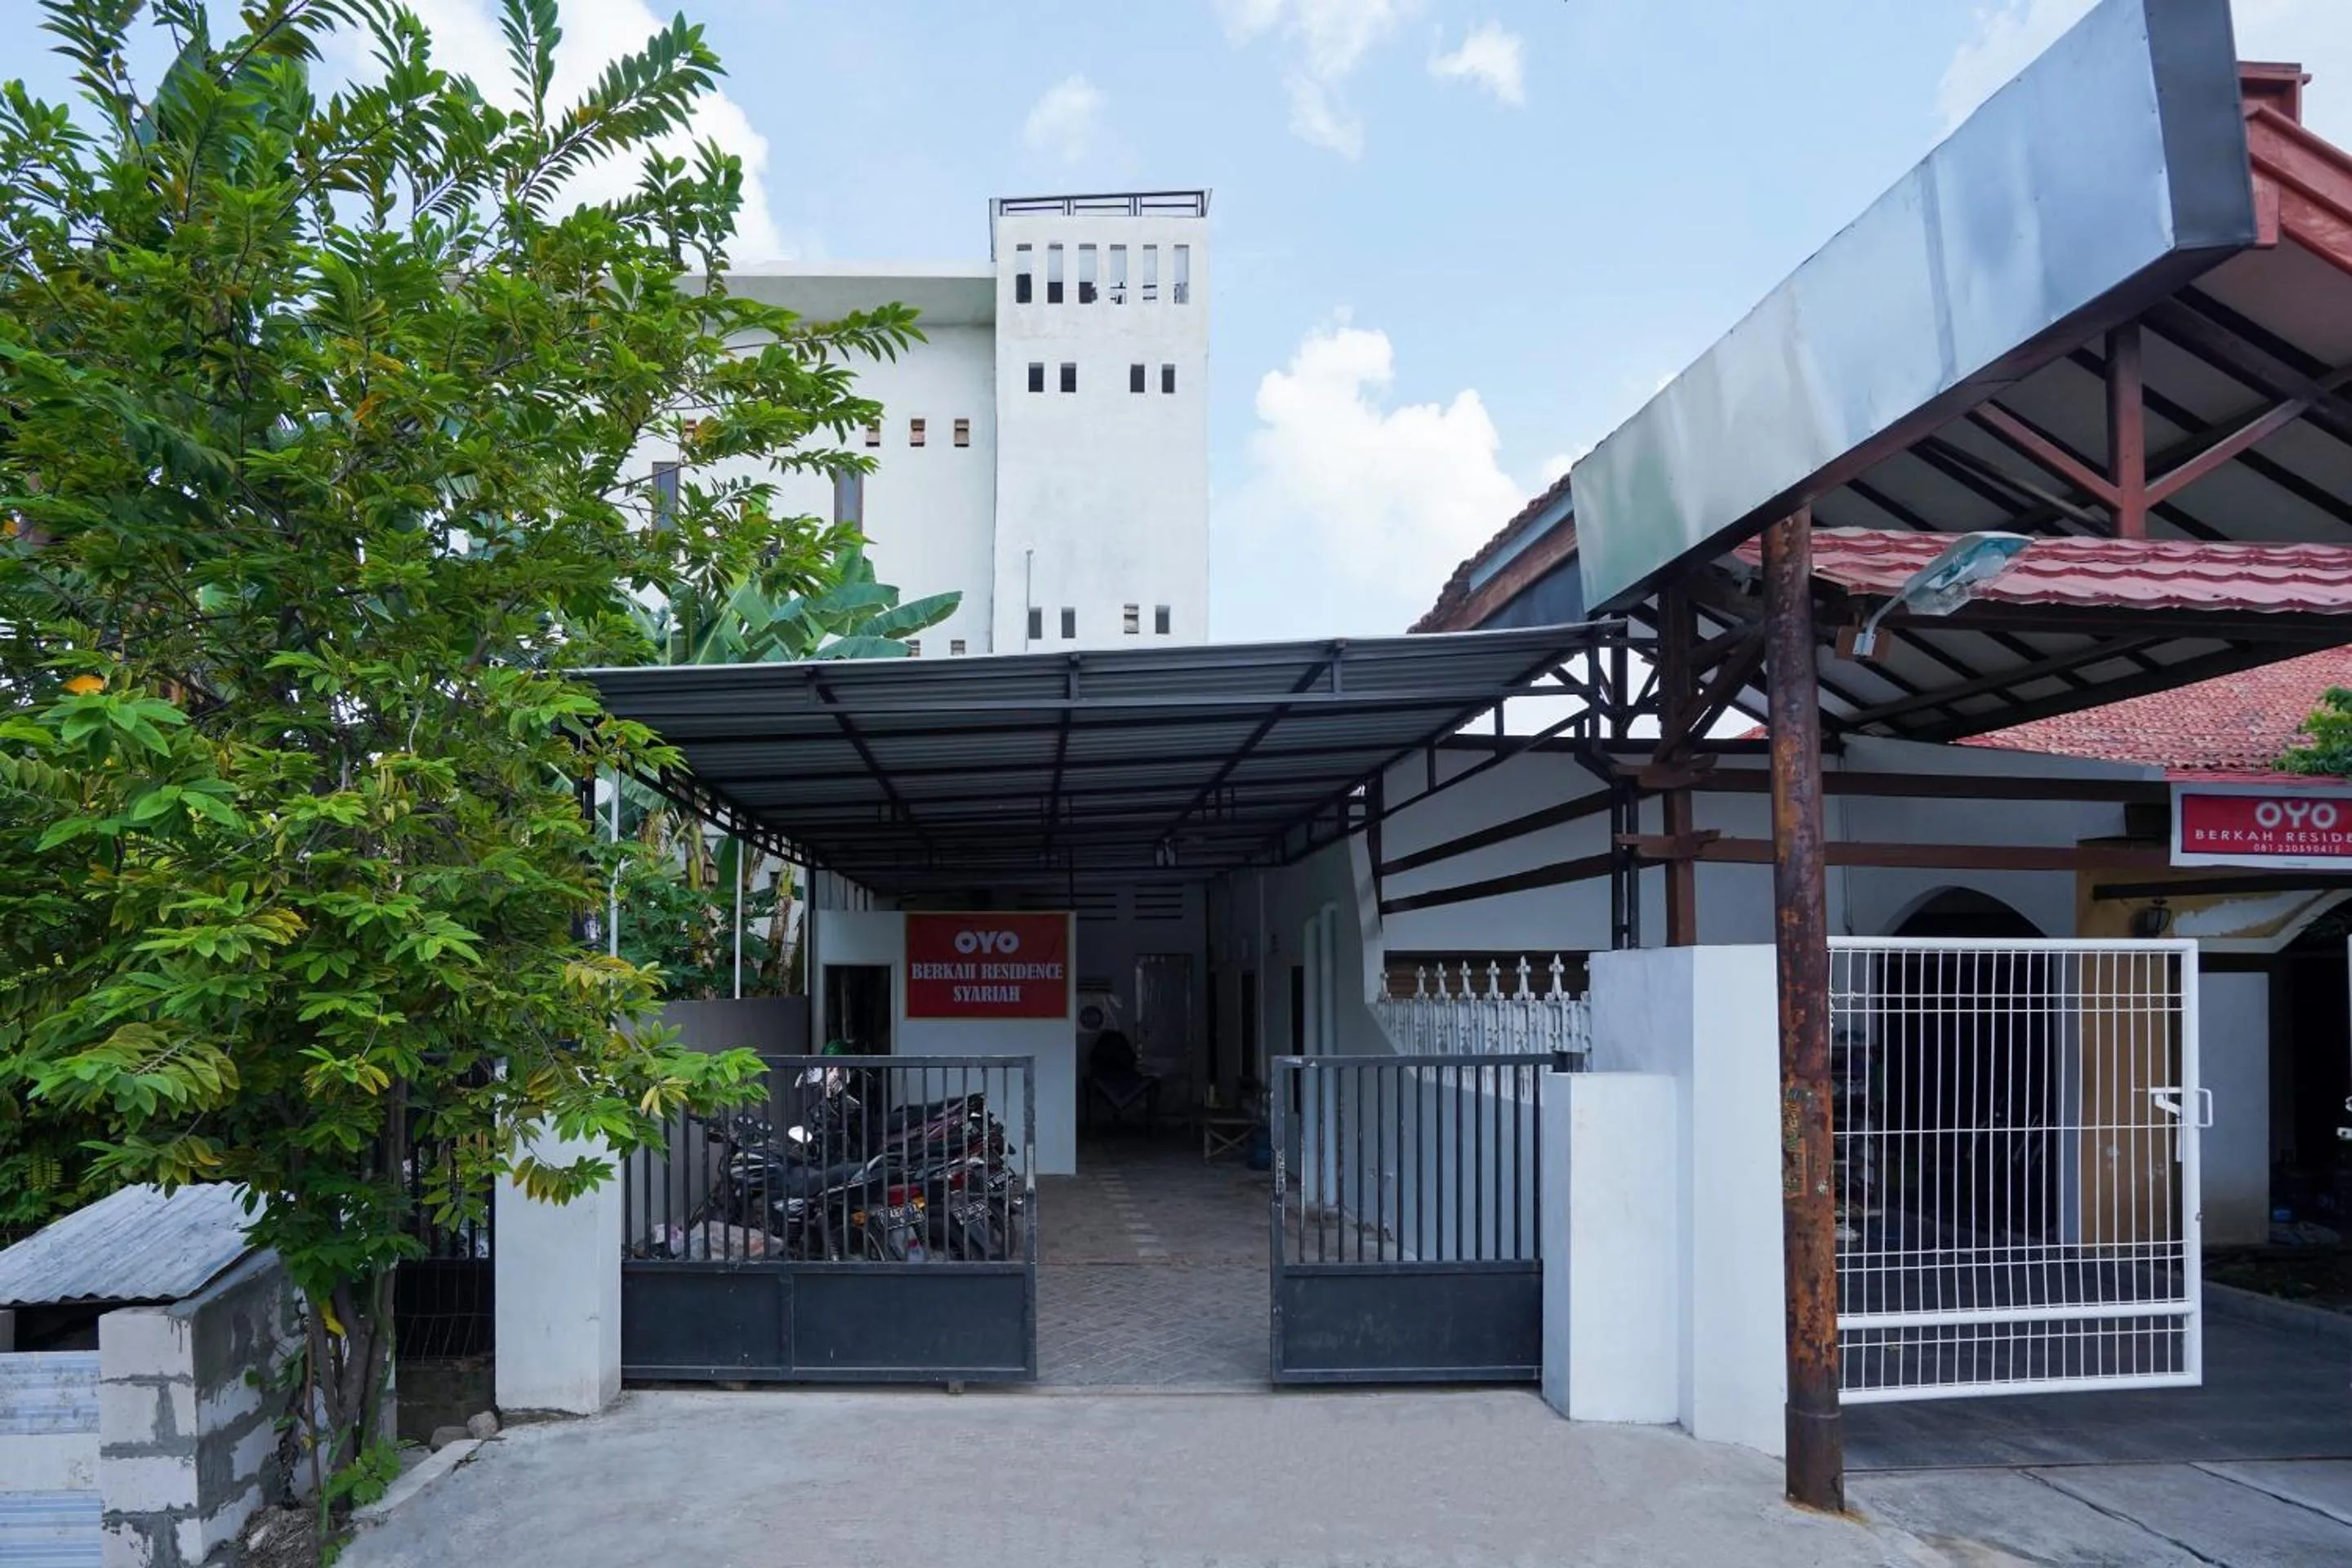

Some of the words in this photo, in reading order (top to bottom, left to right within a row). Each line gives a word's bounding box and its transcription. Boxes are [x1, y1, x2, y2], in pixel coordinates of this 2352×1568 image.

[2255, 801, 2337, 829] OYO
[2195, 829, 2274, 841] BERKAH
[954, 931, 1019, 954] OYO
[912, 963, 976, 980] BERKAH
[982, 963, 1062, 980] RESIDENCE
[954, 986, 1020, 1002] SYARIAH
